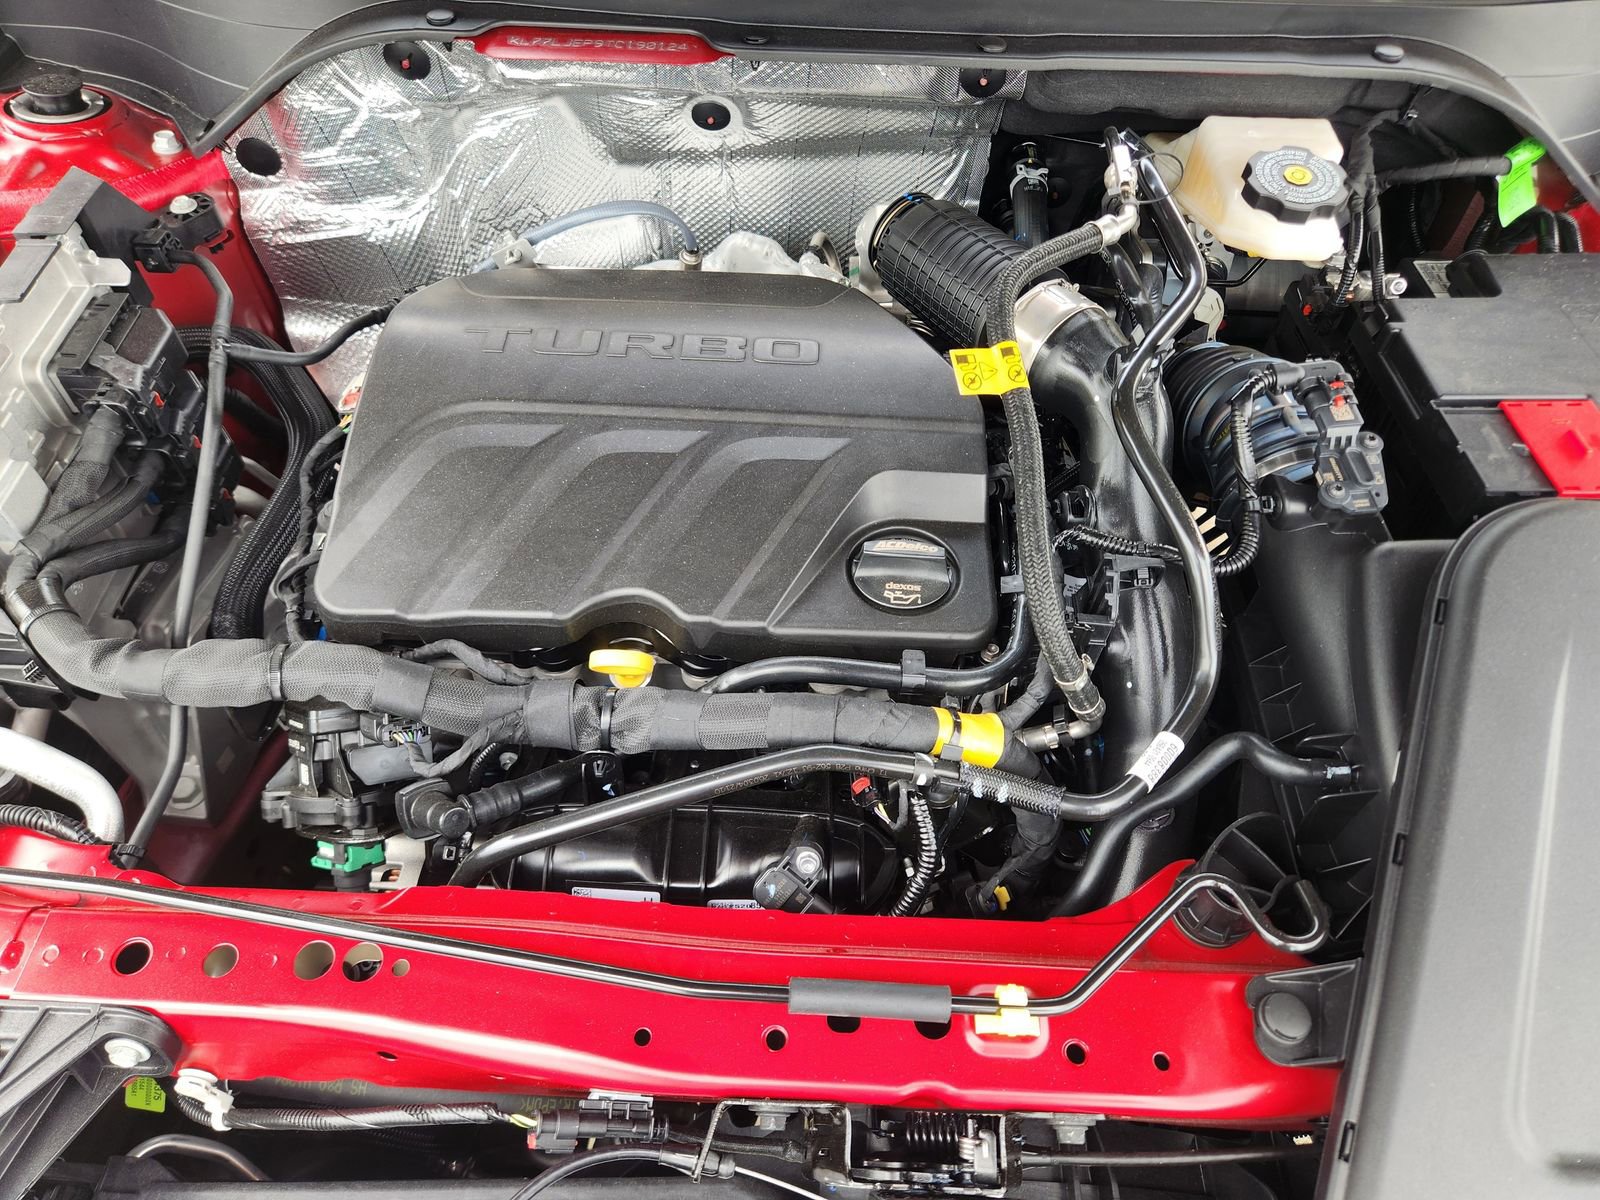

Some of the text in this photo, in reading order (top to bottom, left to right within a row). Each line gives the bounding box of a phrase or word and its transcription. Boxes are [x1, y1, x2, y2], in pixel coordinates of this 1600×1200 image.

[464, 328, 820, 365] TURBO
[873, 539, 940, 553] ACDelco
[885, 582, 922, 592] dexos
